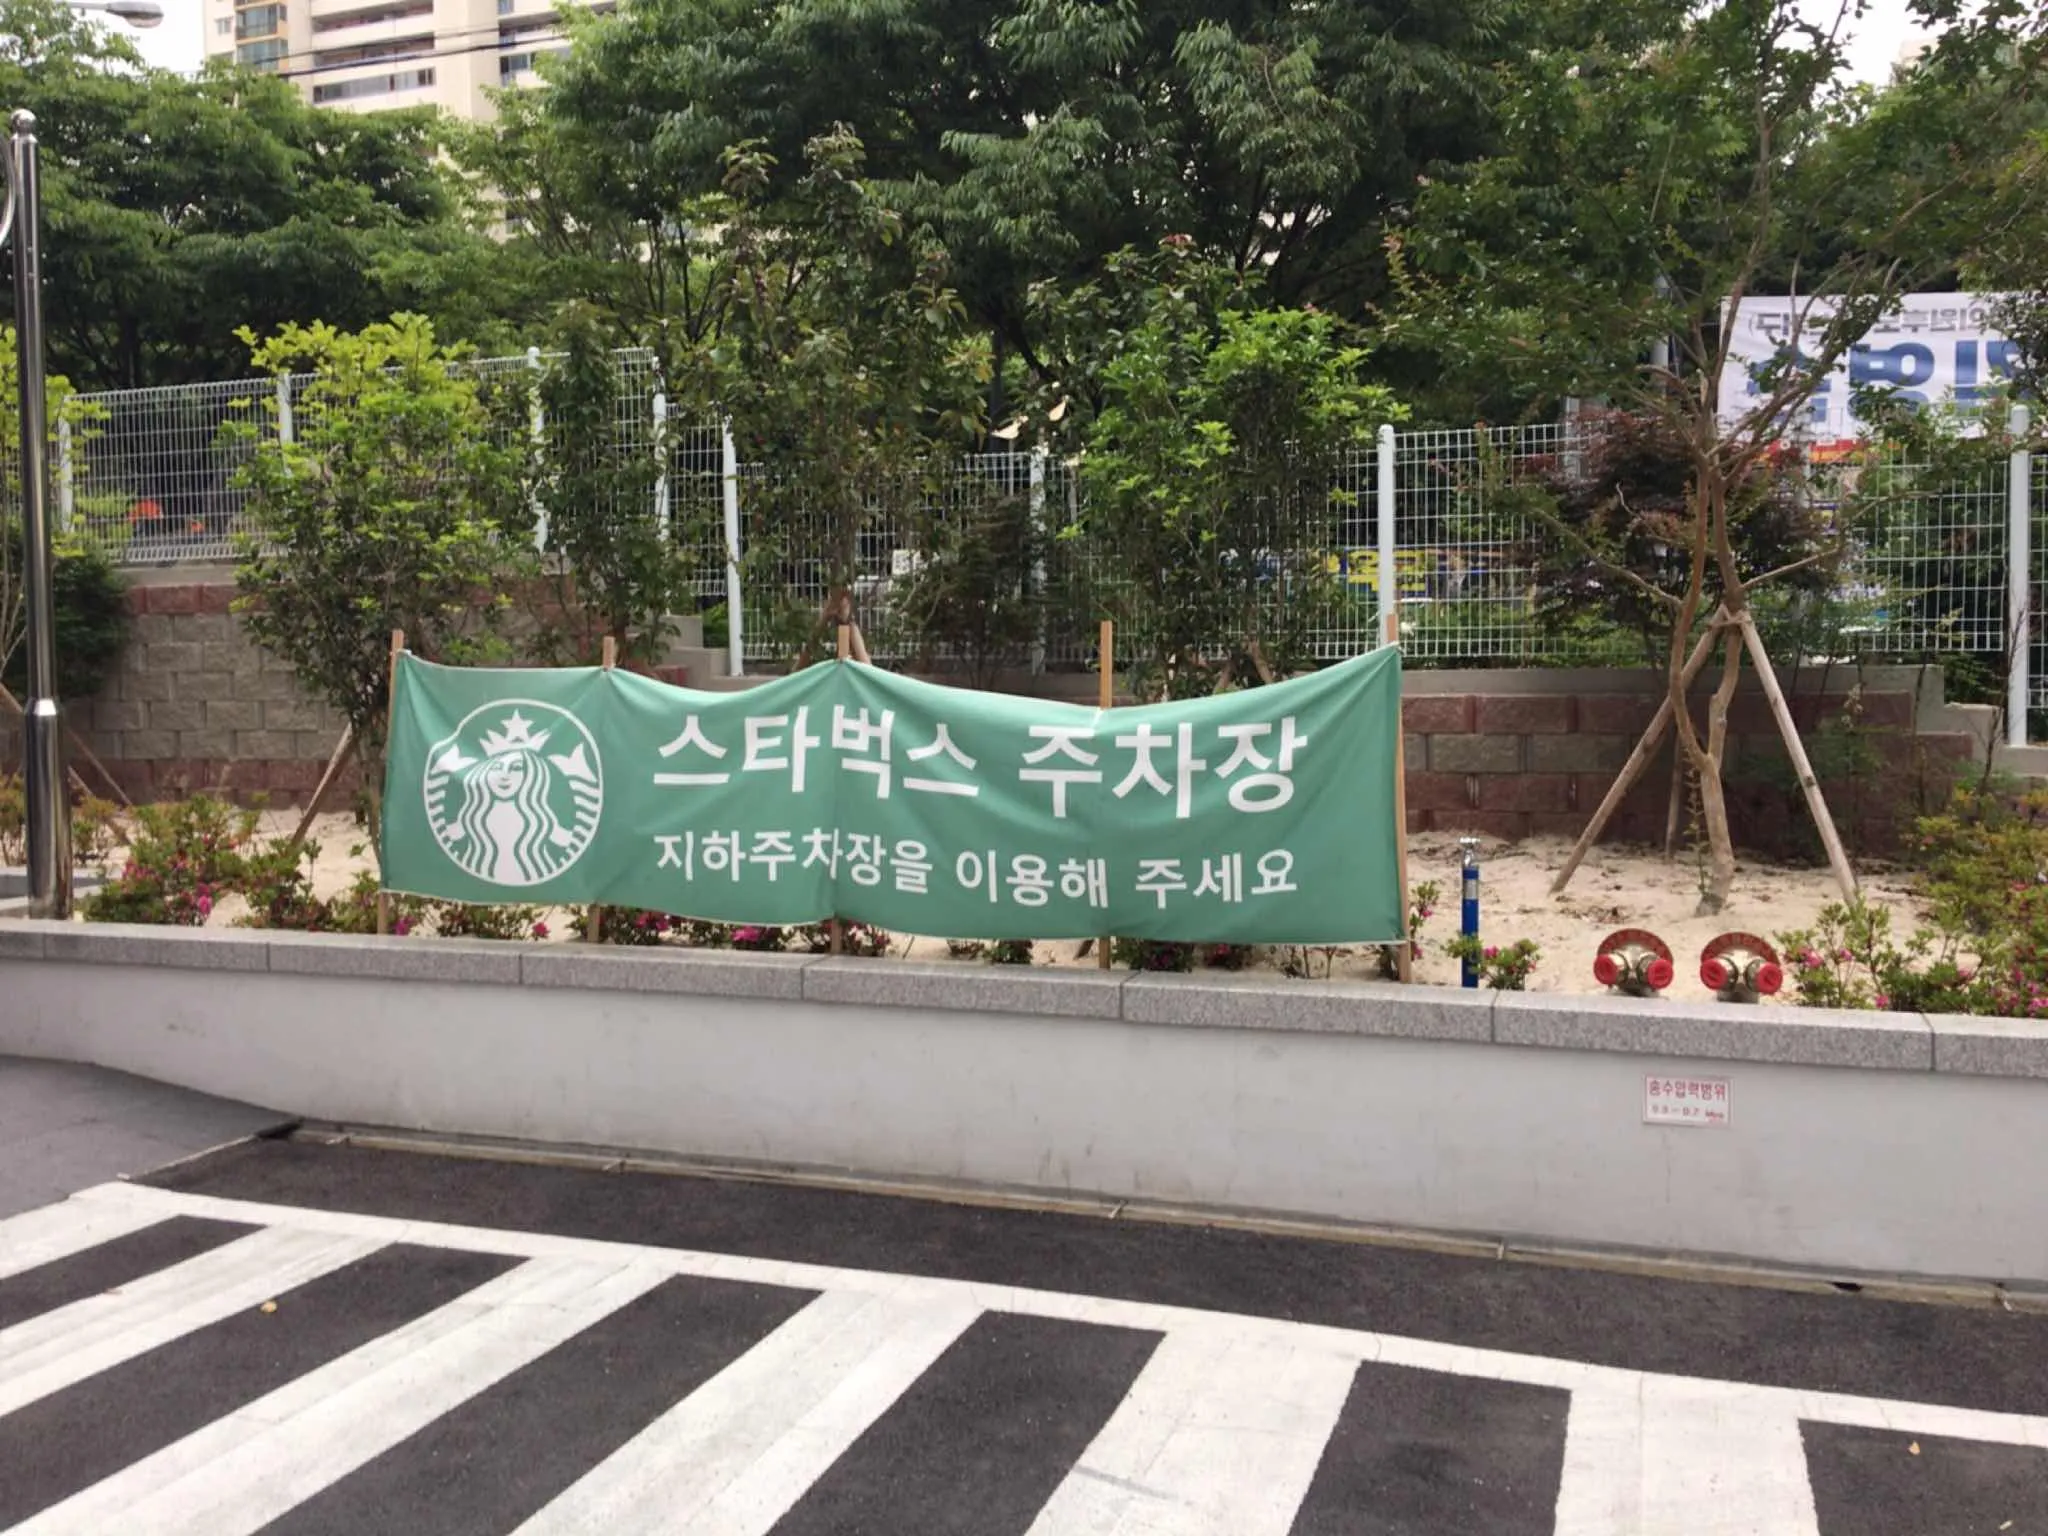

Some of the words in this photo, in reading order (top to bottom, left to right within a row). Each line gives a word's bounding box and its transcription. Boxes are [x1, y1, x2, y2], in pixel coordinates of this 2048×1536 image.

[653, 704, 979, 799] 스타벅스
[1018, 716, 1308, 819] 주차장
[653, 828, 933, 894] 지하주차장을
[956, 849, 1108, 908] 이용해
[1136, 849, 1297, 909] 주세요
[1649, 1080, 1725, 1101] 송수압력범위
